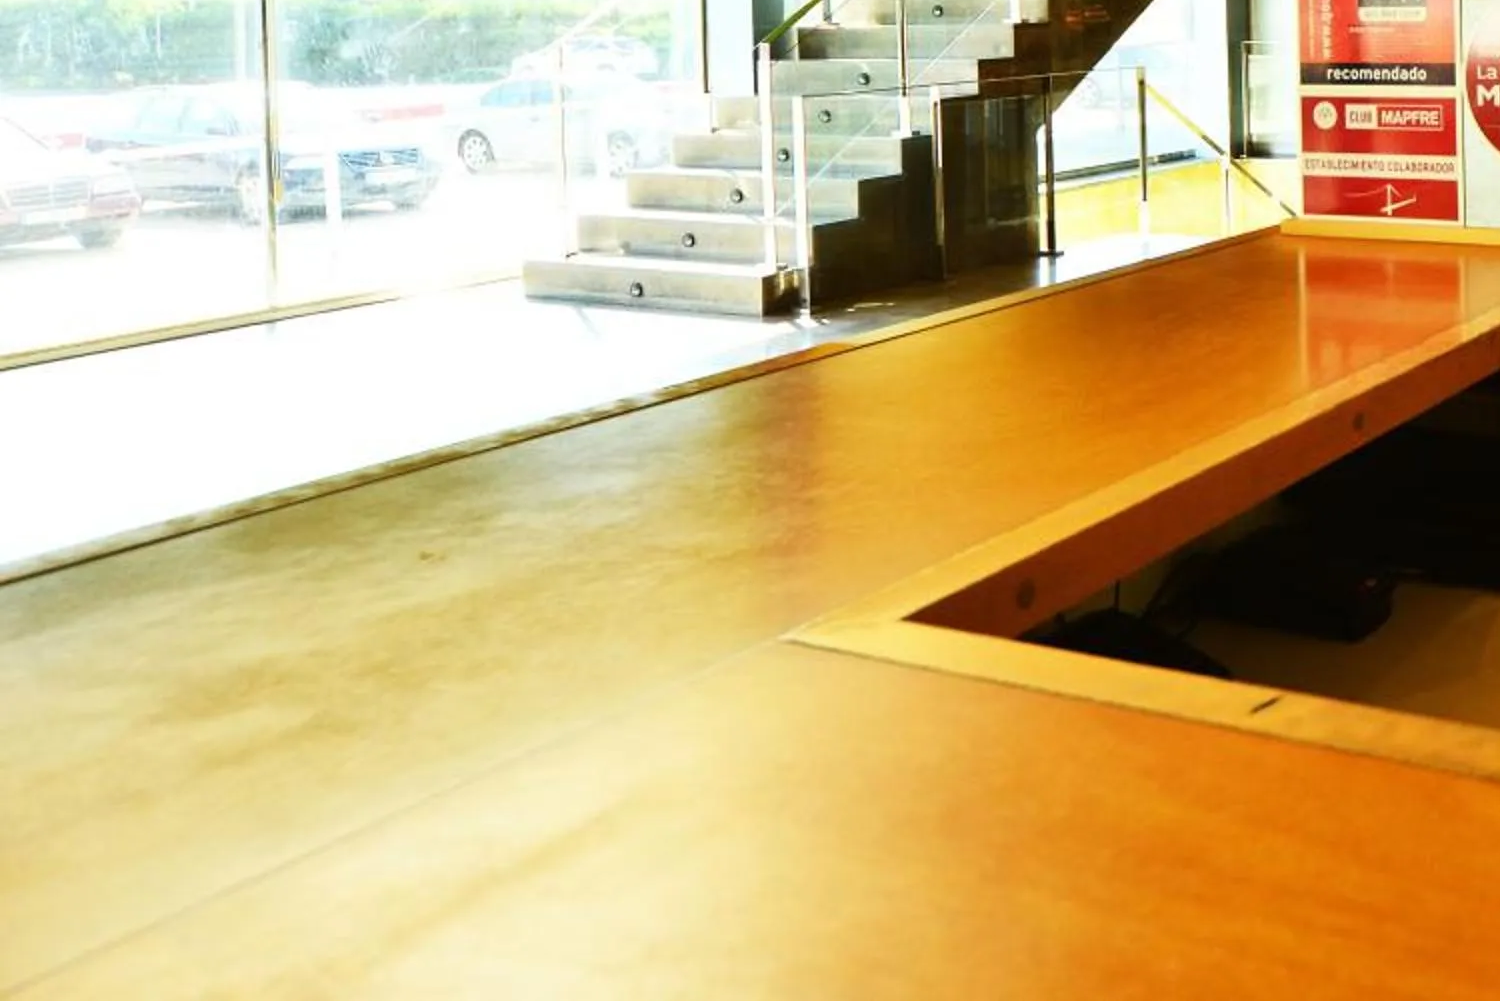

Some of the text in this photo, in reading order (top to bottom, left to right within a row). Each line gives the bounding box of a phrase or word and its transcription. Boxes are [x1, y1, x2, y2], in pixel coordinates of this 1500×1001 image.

[1326, 66, 1428, 81] recomendado
[1476, 64, 1498, 80] La
[1349, 110, 1440, 126] CLUB MAPFRE
[1304, 158, 1455, 174] ESTABLECIMIENTO COLABORADOR
